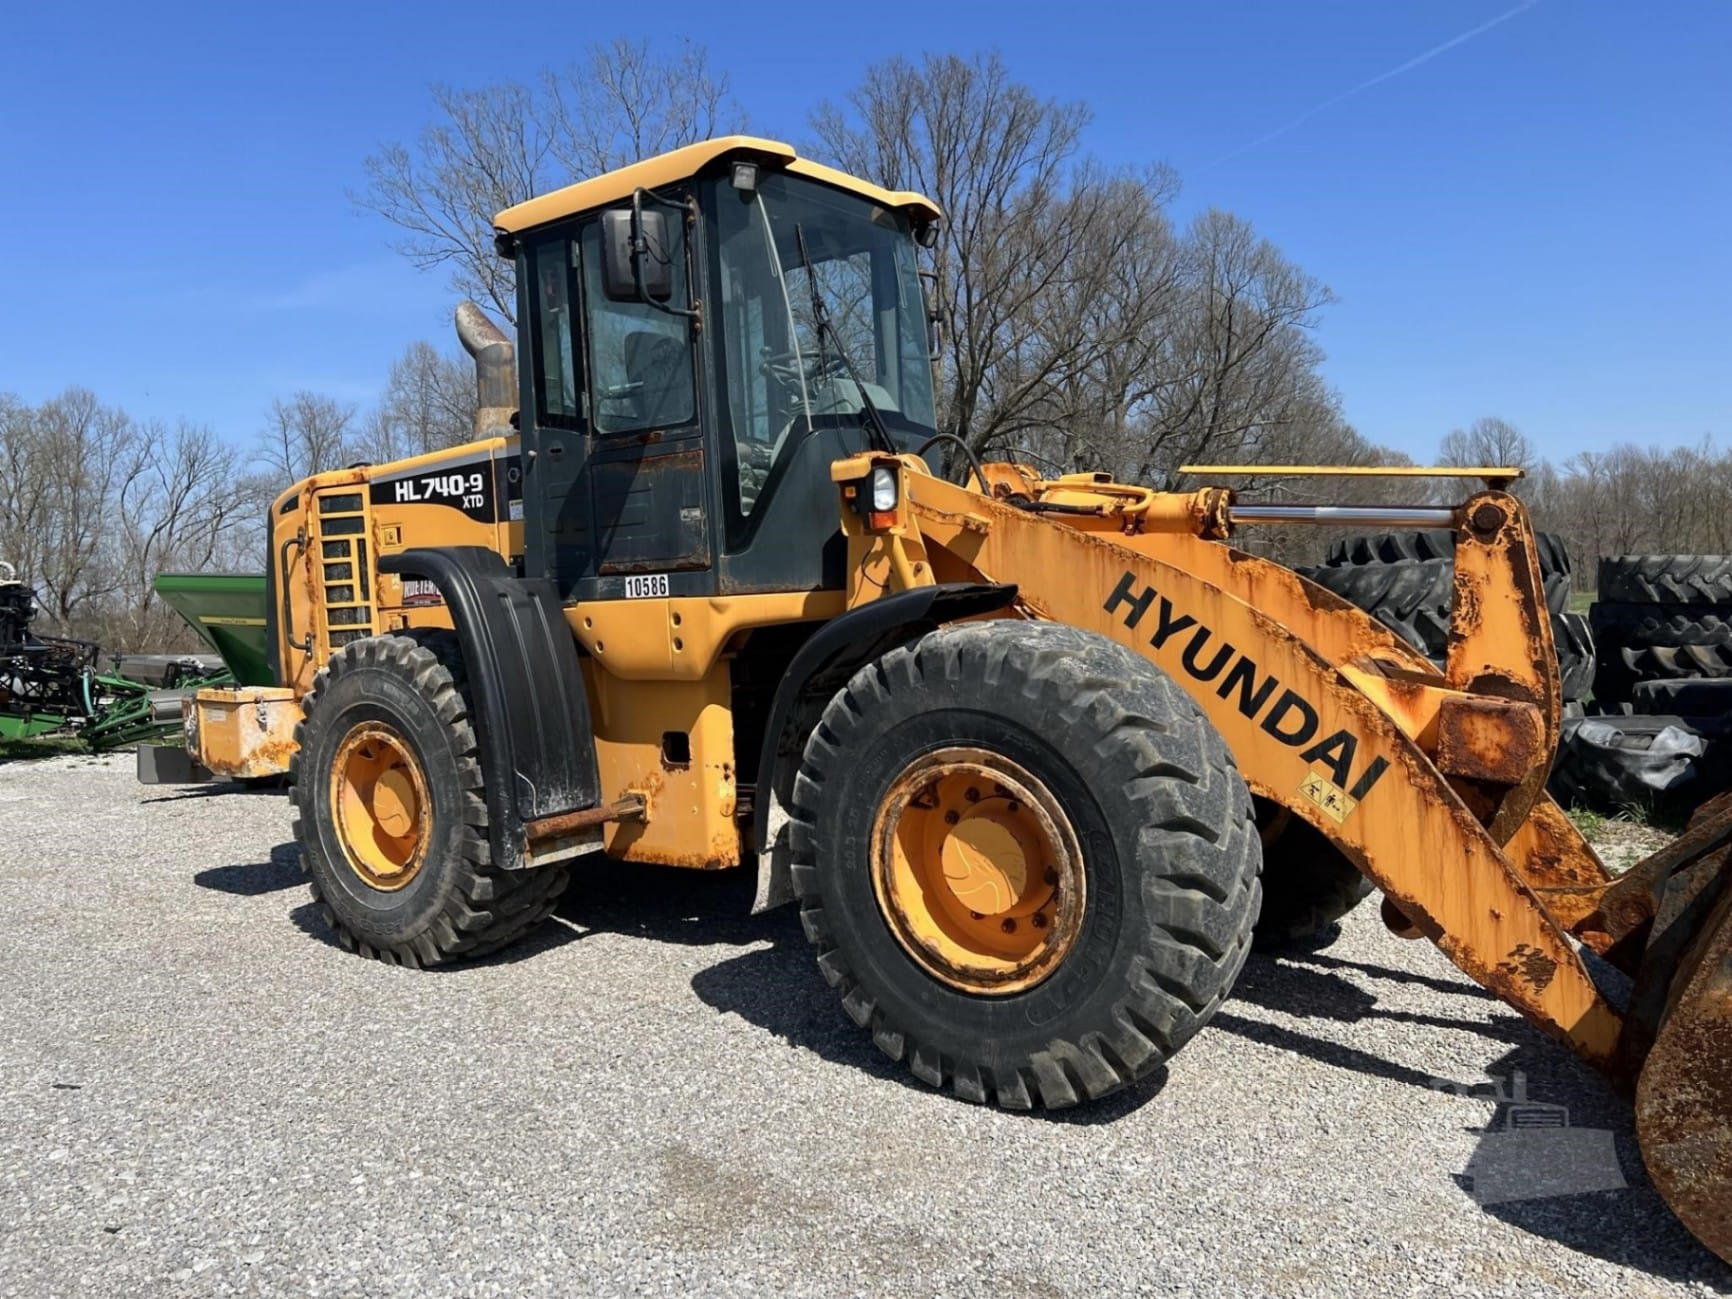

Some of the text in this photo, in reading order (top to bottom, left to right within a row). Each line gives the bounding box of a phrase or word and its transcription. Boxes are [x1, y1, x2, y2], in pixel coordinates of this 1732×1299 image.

[462, 494, 484, 509] XTD
[627, 576, 667, 596] 10586
[1103, 570, 1390, 802] HYUNDAI
